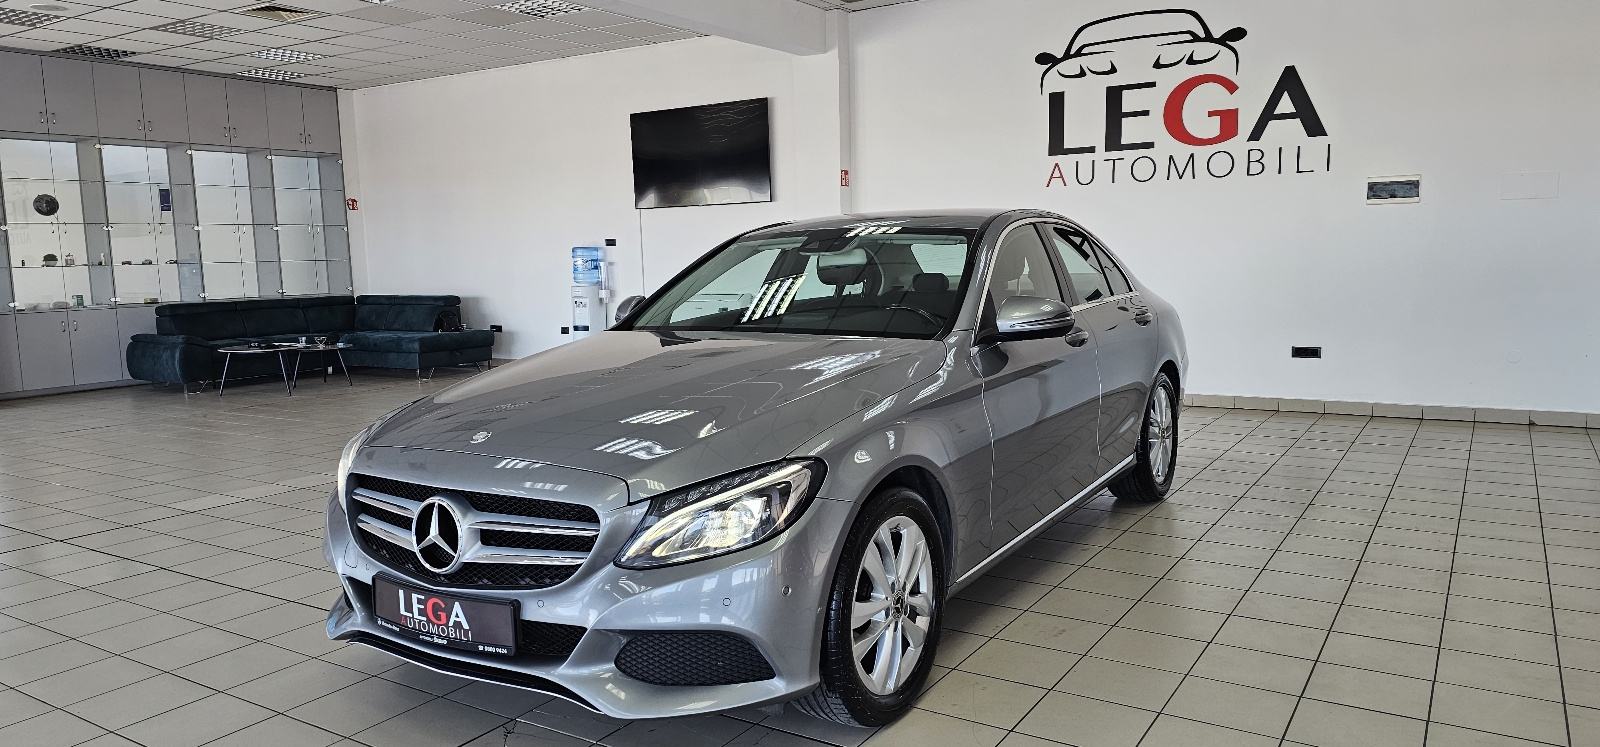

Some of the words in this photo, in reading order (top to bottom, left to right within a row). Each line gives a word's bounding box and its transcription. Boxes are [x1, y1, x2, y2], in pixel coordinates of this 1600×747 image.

[1048, 65, 1328, 156] LEGA
[1046, 144, 1331, 188] AUTOMOBILI
[399, 589, 470, 630] LEGA
[401, 616, 472, 641] AUTOMOBILI
